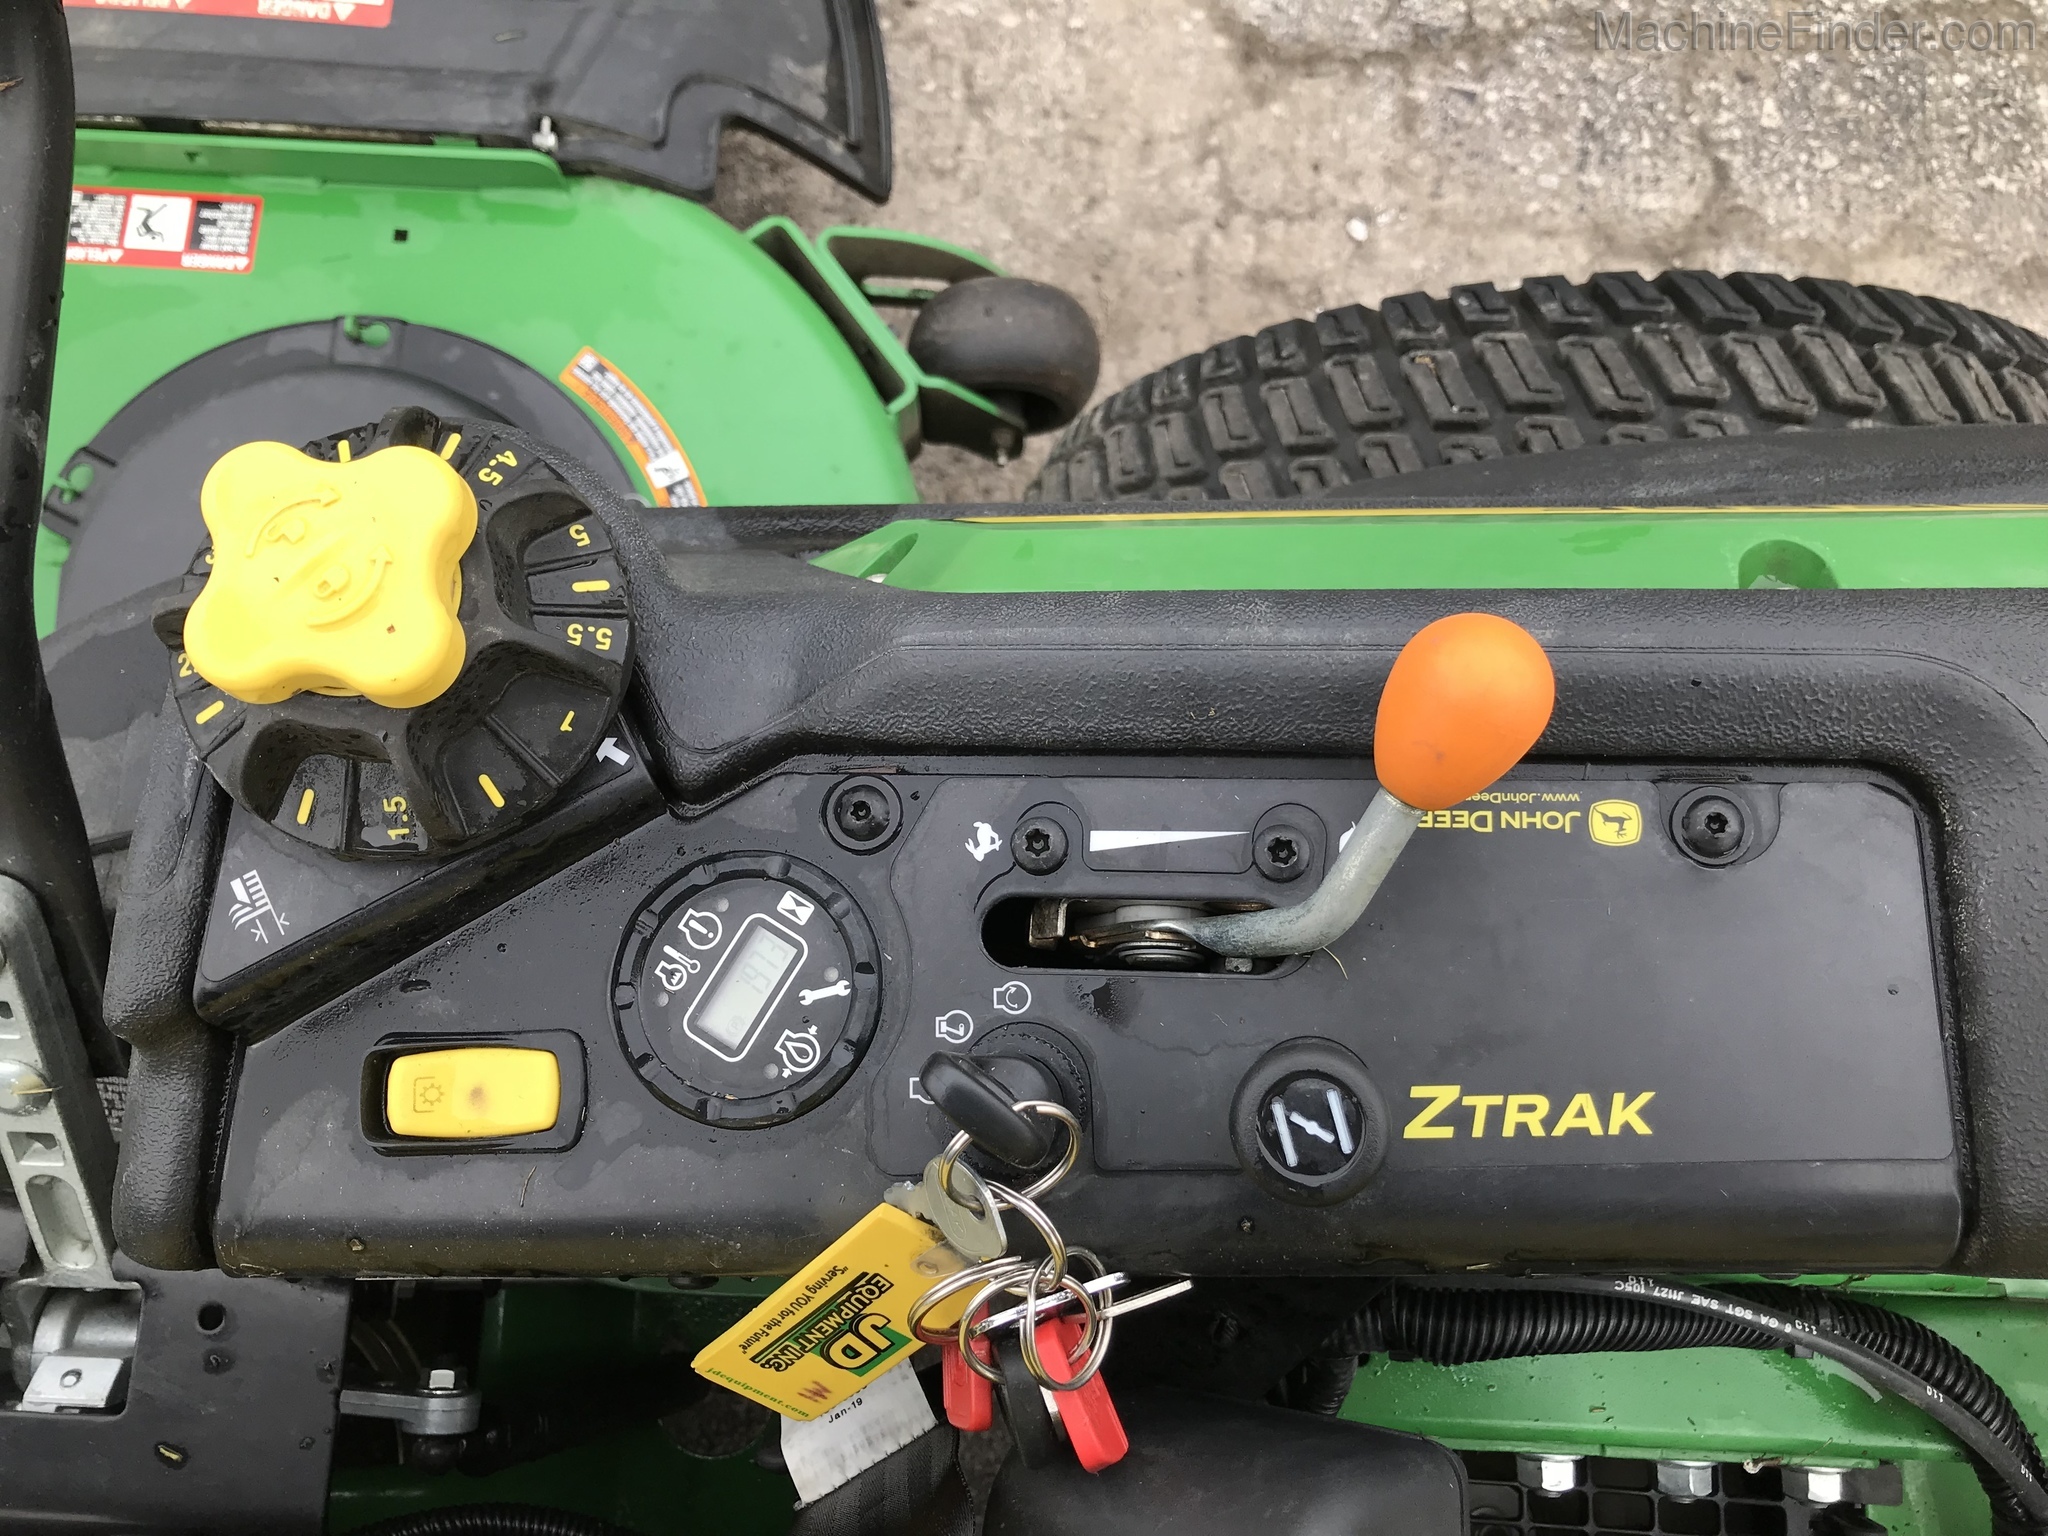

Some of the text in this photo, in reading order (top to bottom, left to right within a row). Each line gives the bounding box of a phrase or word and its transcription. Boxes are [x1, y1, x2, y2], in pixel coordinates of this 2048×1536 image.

[257, 4, 332, 20] DANGER
[478, 449, 517, 487] 4.5
[569, 524, 591, 547] 5
[567, 623, 613, 651] 5.5
[560, 711, 575, 732] 1
[382, 796, 409, 840] 1.5
[1500, 811, 1581, 834] JOHN
[1402, 1084, 1657, 1139] ZTRAK
[790, 1293, 815, 1312] YOU
[1653, 1286, 1684, 1301] J1127
[1691, 1293, 1719, 1310] SAE
[760, 1273, 894, 1372] EQUIPMENT INC.
[777, 1308, 796, 1320] for
[1725, 1303, 1753, 1320] SGT
[1760, 1313, 1779, 1329] GA
[763, 1318, 782, 1332] the
[820, 1312, 896, 1370] JD
[704, 1367, 810, 1418] jdequipment.com
[828, 1397, 864, 1424] Jan-19
